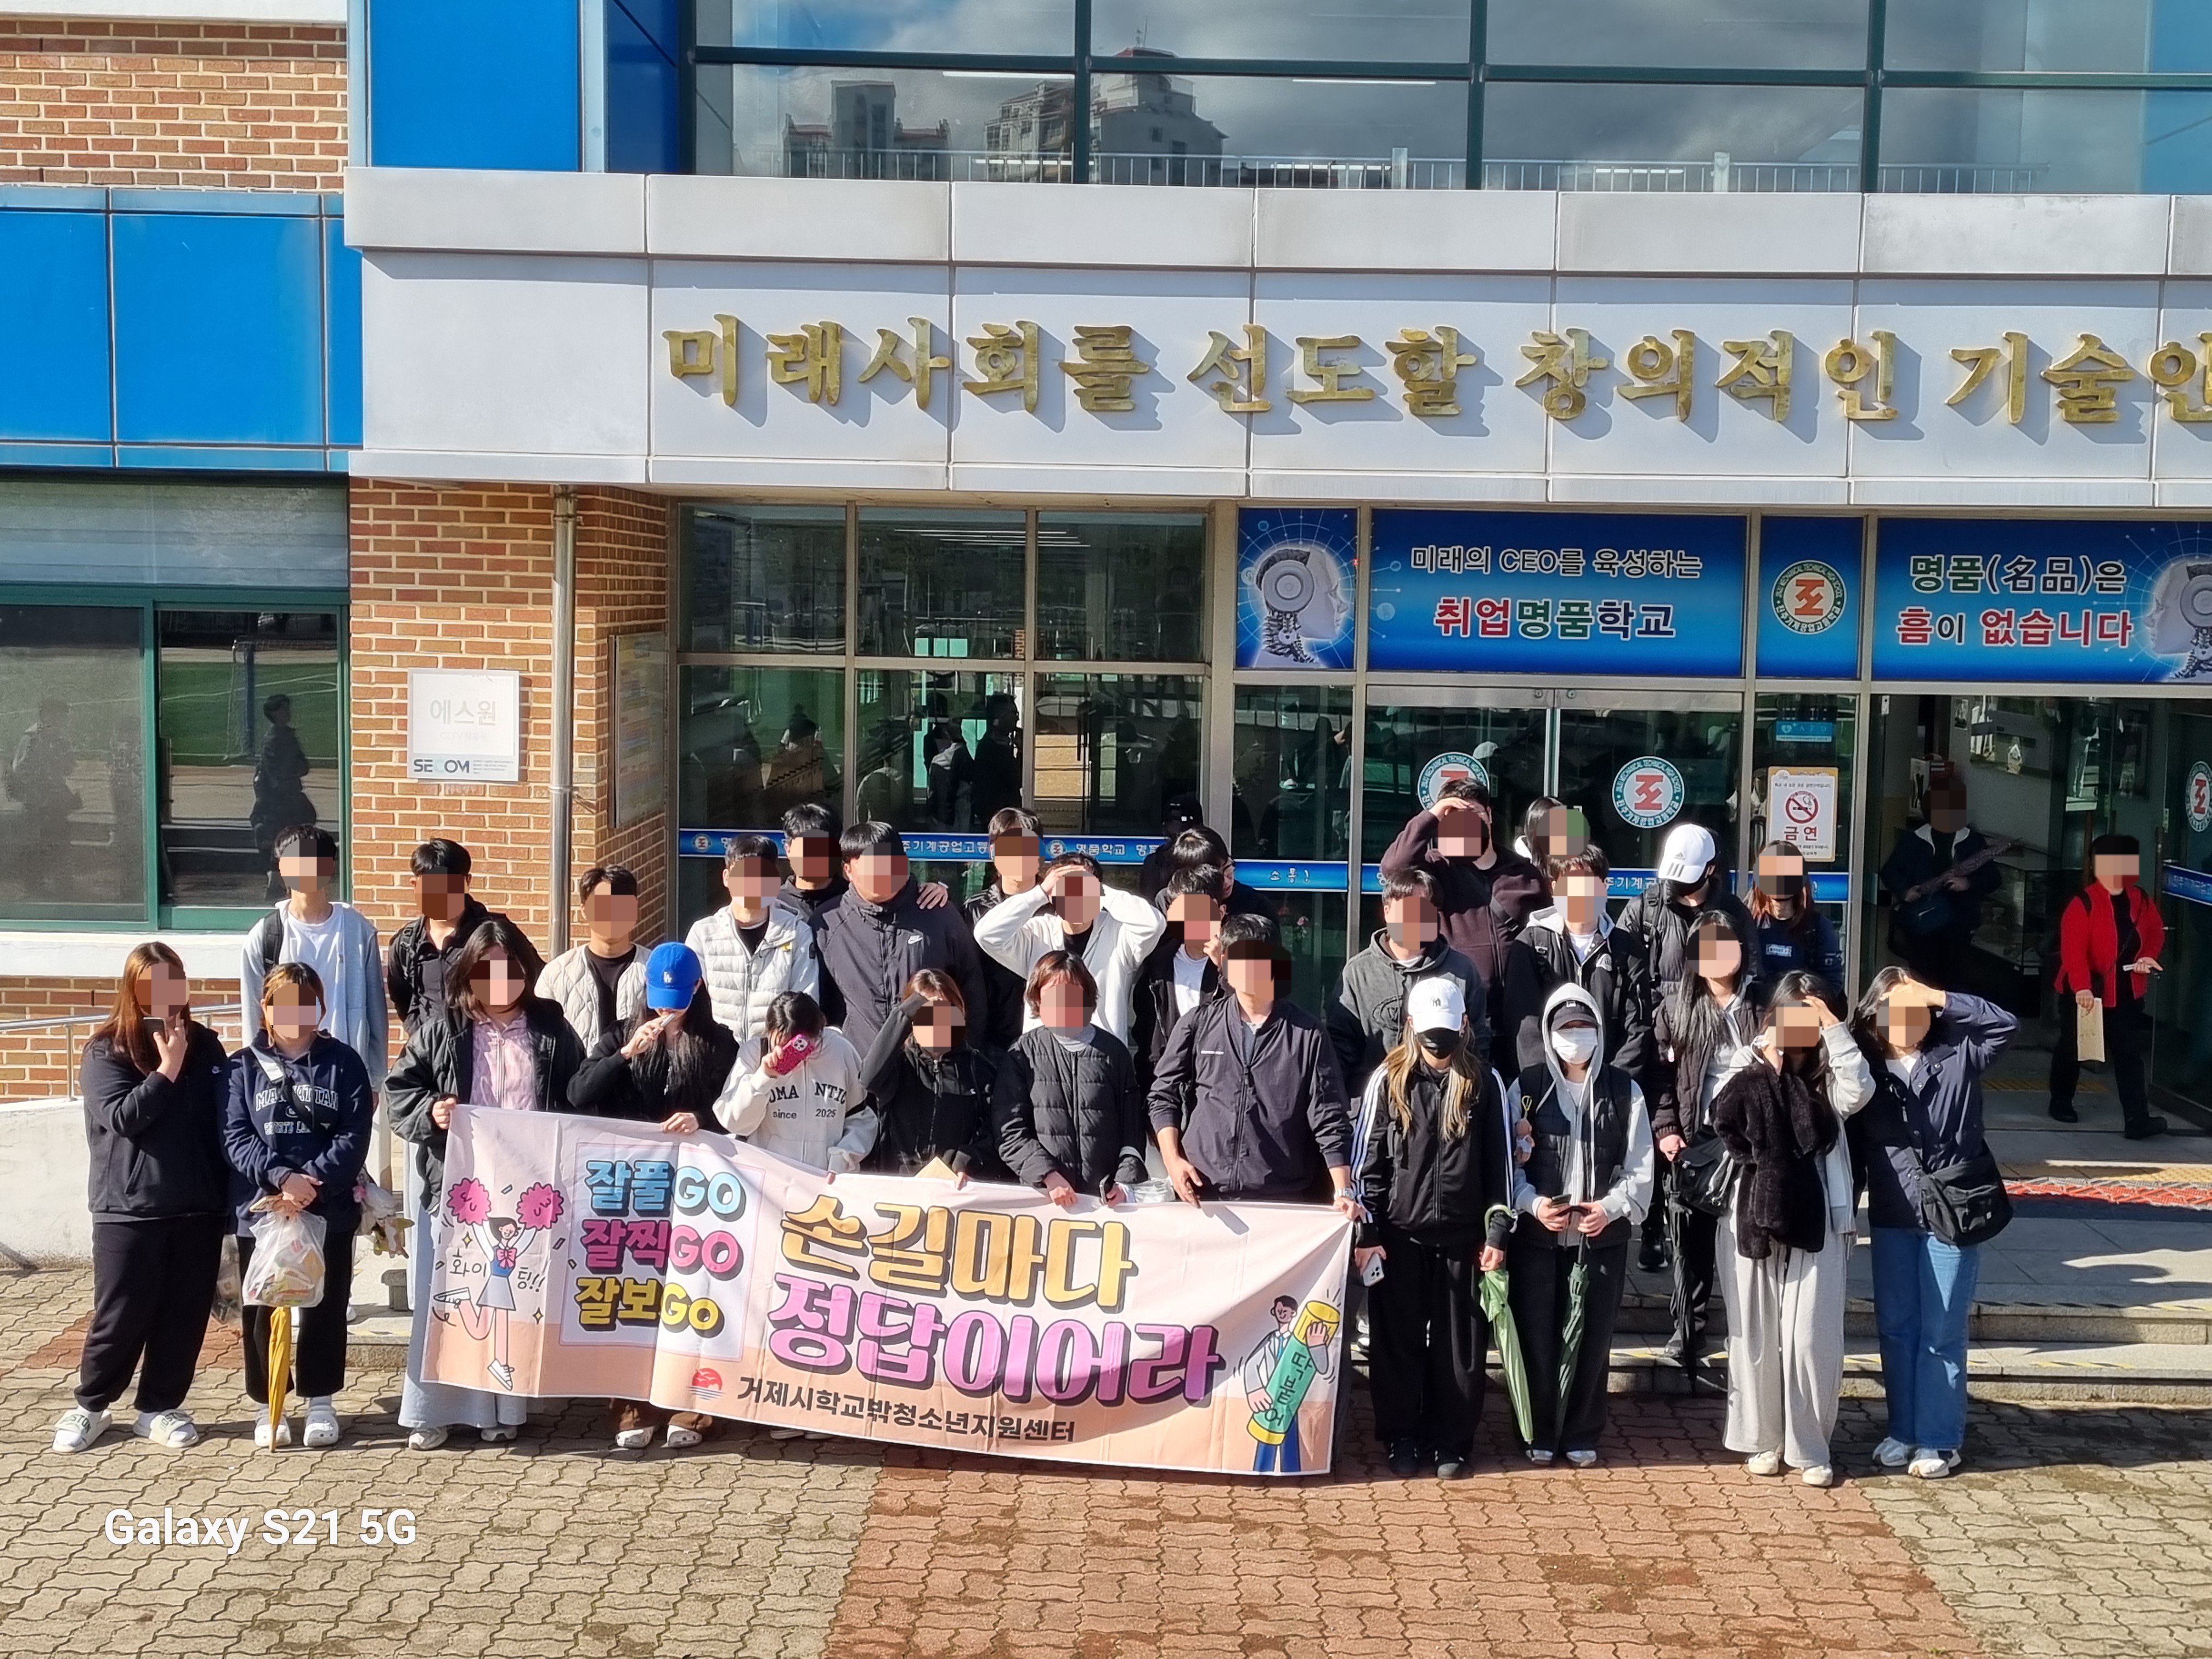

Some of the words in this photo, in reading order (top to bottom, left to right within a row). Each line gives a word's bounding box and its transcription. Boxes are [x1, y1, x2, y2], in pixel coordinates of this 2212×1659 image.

[662, 313, 1148, 413] 미래사회를
[1187, 324, 1477, 416] 선도할
[1515, 327, 1898, 422] 창의적인
[1410, 545, 1491, 574] 미래의
[1499, 548, 1586, 577] CEO를
[1593, 548, 1704, 578] 육성하는
[1910, 553, 2127, 595] 명품(名品)은
[1434, 596, 1677, 640] 취업명품학교
[1895, 606, 1966, 646] 흠이
[1979, 608, 2135, 648] 없습니다
[430, 699, 496, 726] 에스원
[1784, 826, 1817, 841] 금연
[256, 1084, 338, 1111] MAATTAN
[772, 1109, 797, 1119] since
[815, 1108, 837, 1118] 2025
[583, 1159, 747, 1223] 잘풀GO
[580, 1219, 744, 1281] 잘찍GO
[780, 1194, 1139, 1313] 손길마다
[767, 1272, 1227, 1409] 정답이어라
[737, 1376, 1075, 1442] 거제시학교밖청소년지원센터
